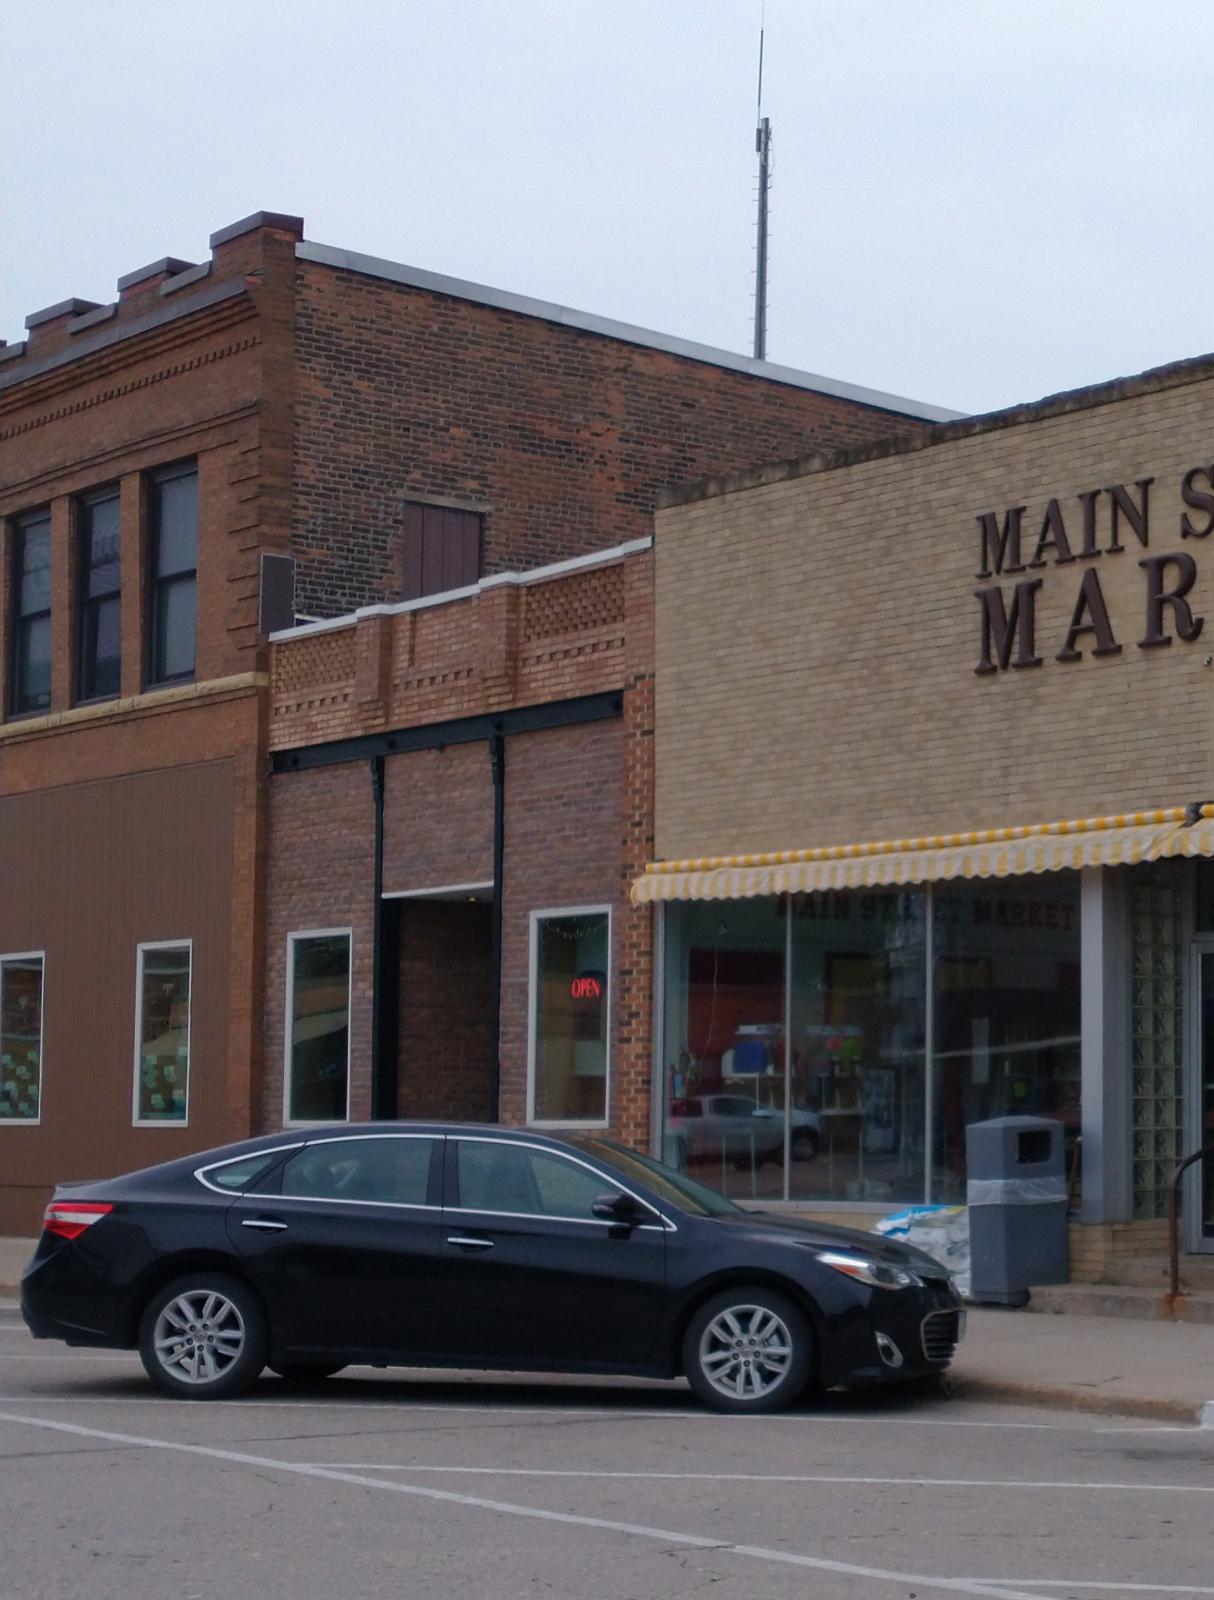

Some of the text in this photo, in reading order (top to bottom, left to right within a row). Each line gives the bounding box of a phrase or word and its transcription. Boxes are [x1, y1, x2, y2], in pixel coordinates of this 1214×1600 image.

[975, 477, 1154, 578] MAIN
[973, 898, 1076, 930] MARKET
[571, 977, 601, 998] OPEN
